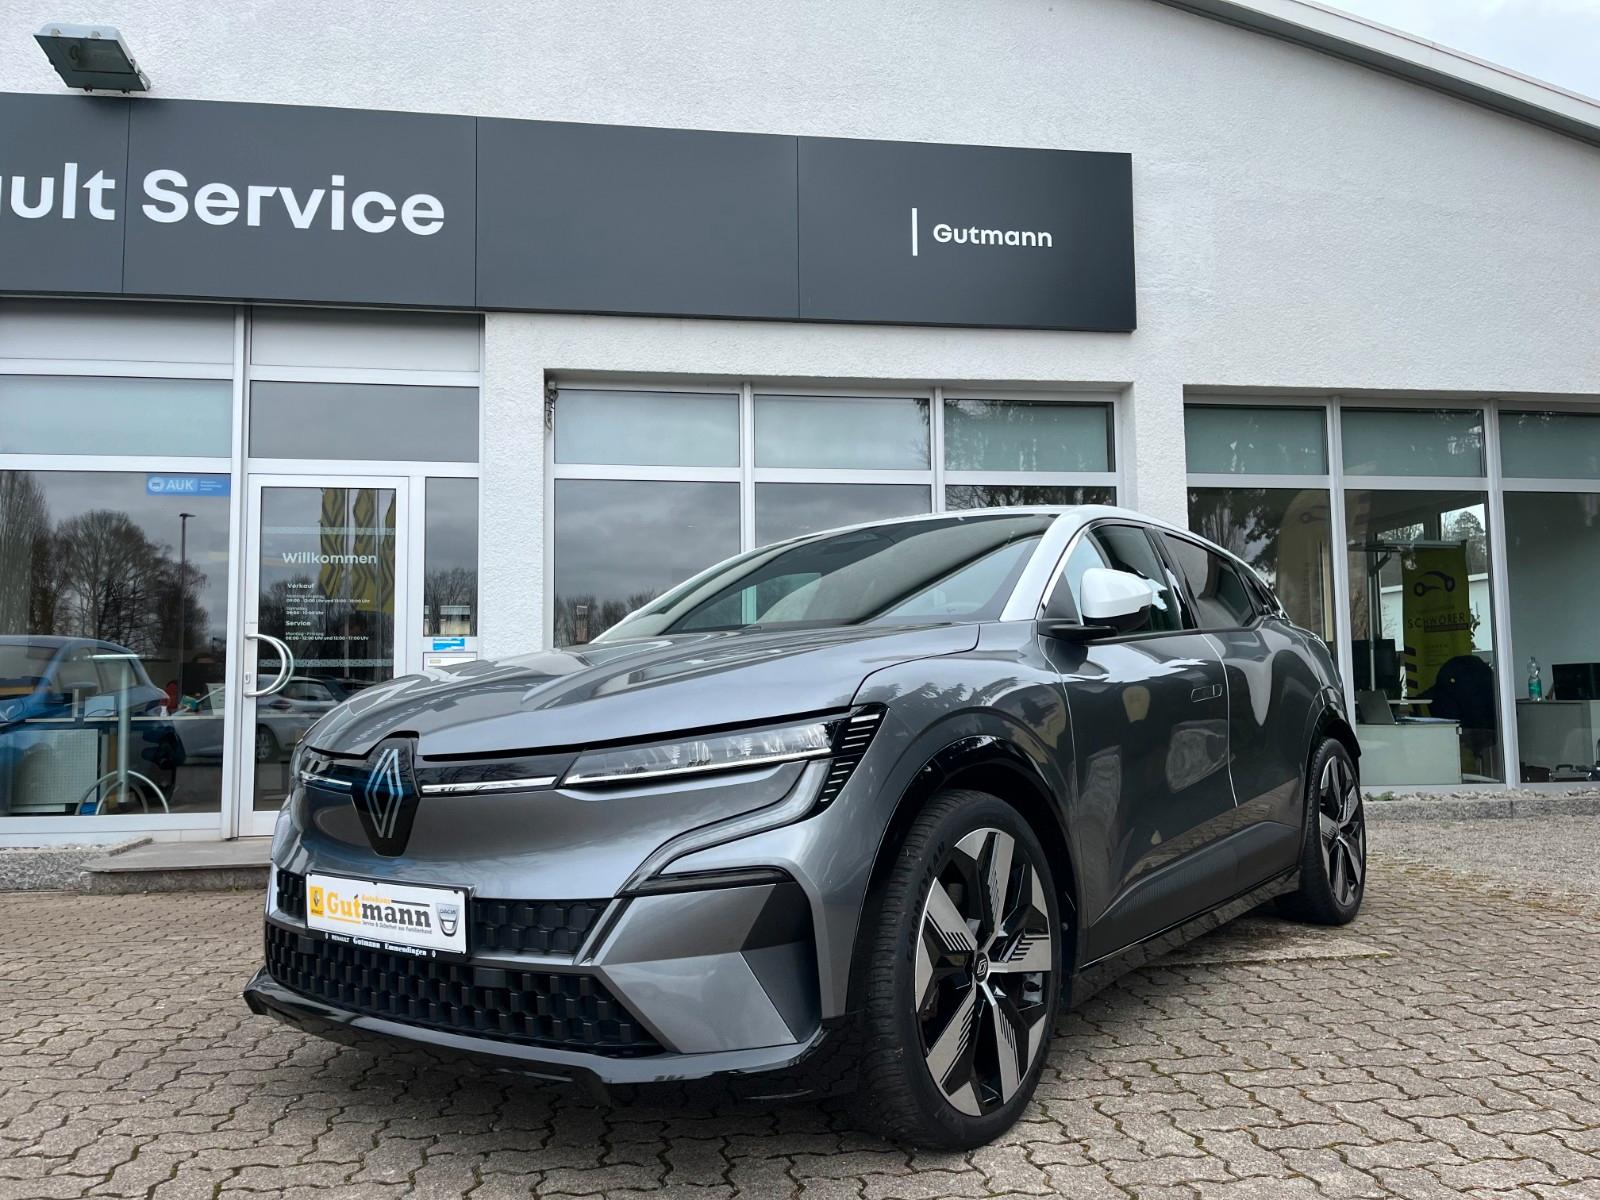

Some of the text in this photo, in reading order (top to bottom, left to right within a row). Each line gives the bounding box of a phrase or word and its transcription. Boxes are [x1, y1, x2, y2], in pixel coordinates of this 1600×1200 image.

[0, 162, 445, 235] ult Service
[933, 223, 1053, 247] Gutmann
[166, 479, 193, 491] AUK
[282, 551, 377, 564] Willkommen
[327, 891, 431, 928] Gutmann
[353, 936, 381, 949] Gutmann
[385, 943, 427, 957] Emmendingen
